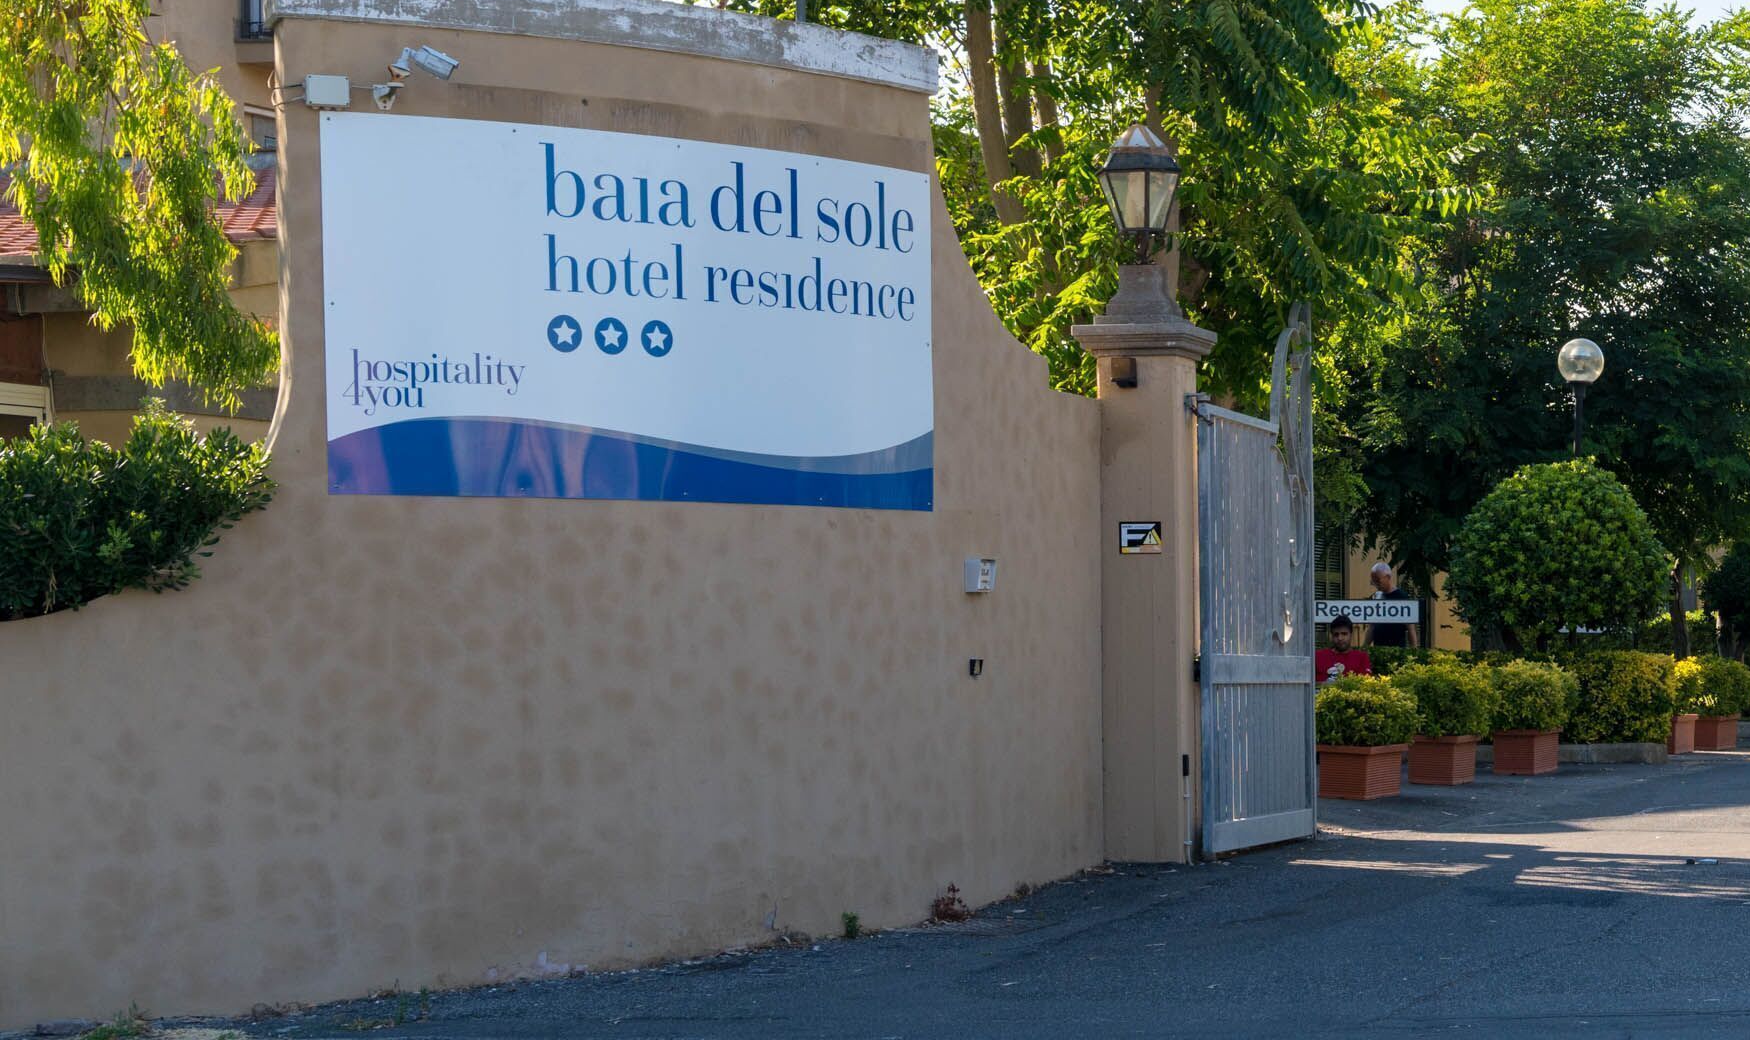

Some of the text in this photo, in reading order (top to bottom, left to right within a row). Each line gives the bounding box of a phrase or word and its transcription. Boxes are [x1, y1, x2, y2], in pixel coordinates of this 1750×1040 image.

[710, 161, 805, 239] del
[816, 181, 915, 254] sole
[543, 233, 915, 322] hotel residence
[351, 347, 527, 396] hospitality
[1315, 602, 1412, 621] Reception
